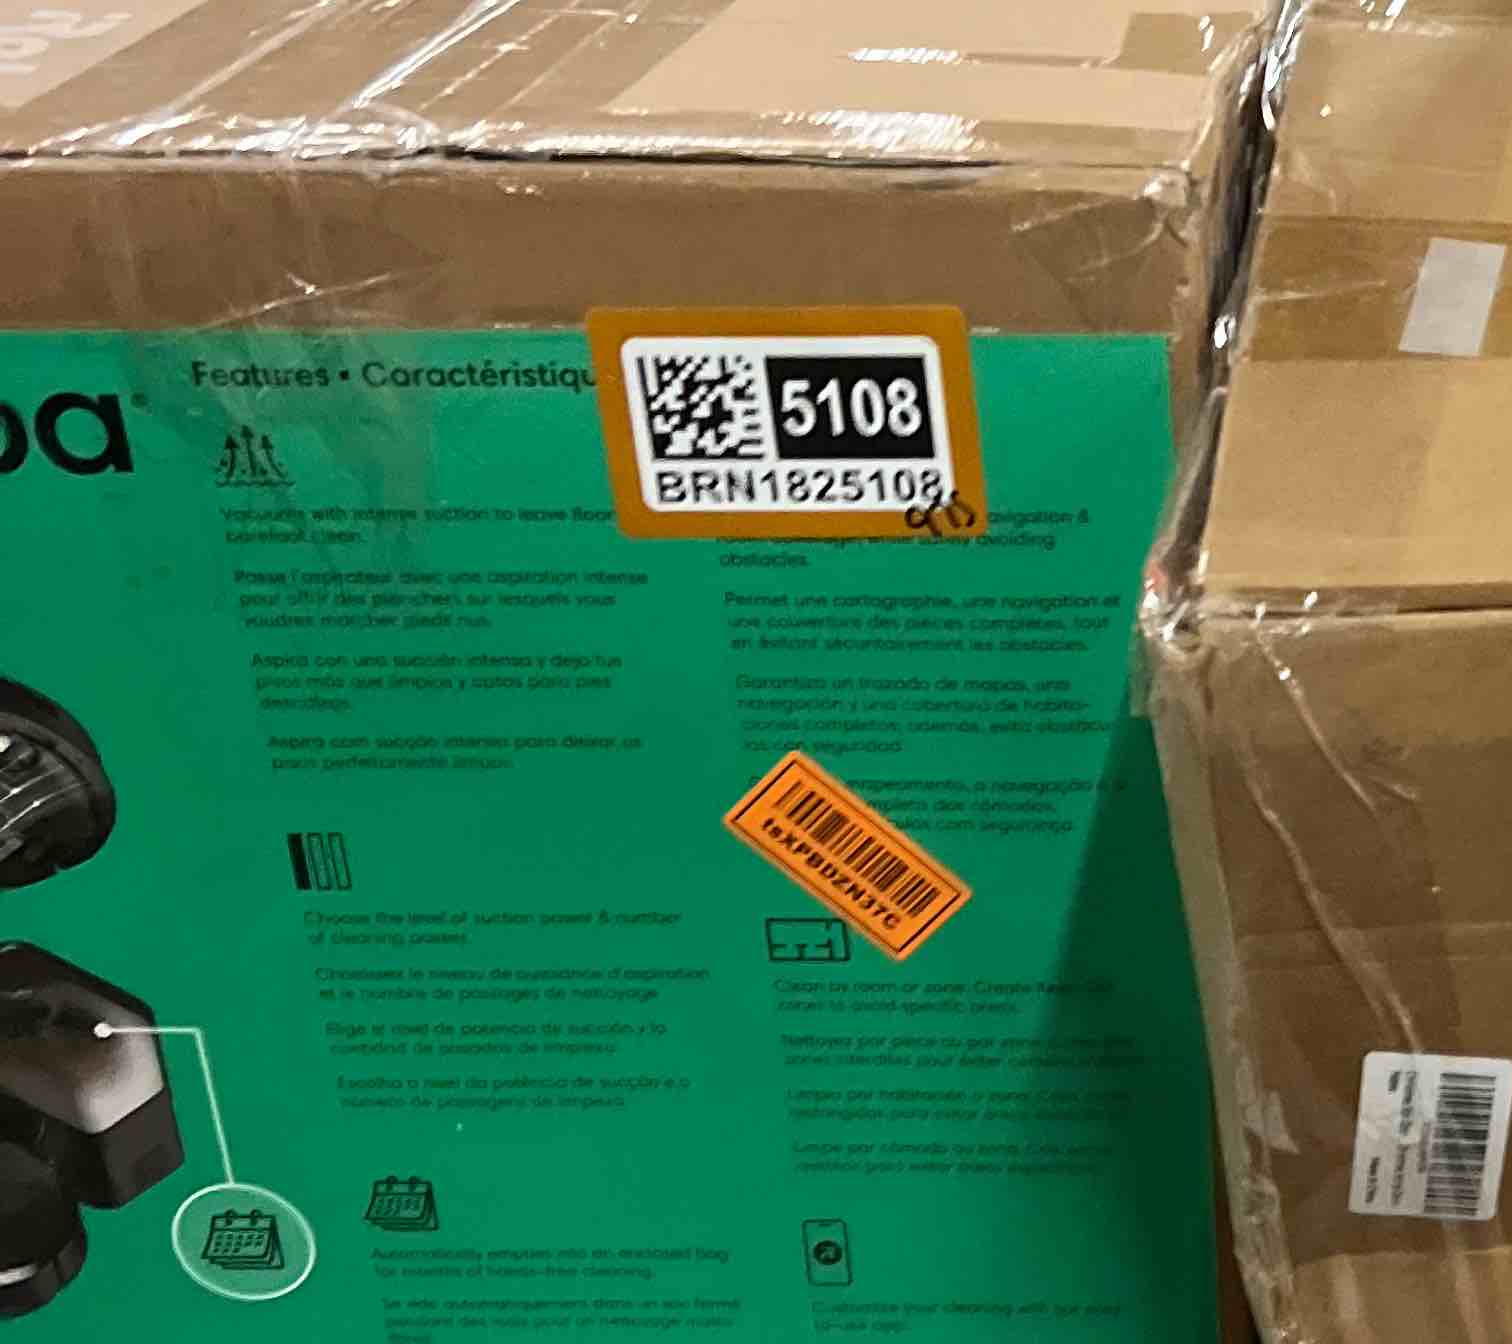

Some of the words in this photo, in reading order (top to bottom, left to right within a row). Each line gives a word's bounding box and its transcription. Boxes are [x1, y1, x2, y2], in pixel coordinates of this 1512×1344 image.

[191, 360, 330, 388] Features
[780, 378, 924, 438] 5108
[655, 467, 944, 505] BRN1825108
